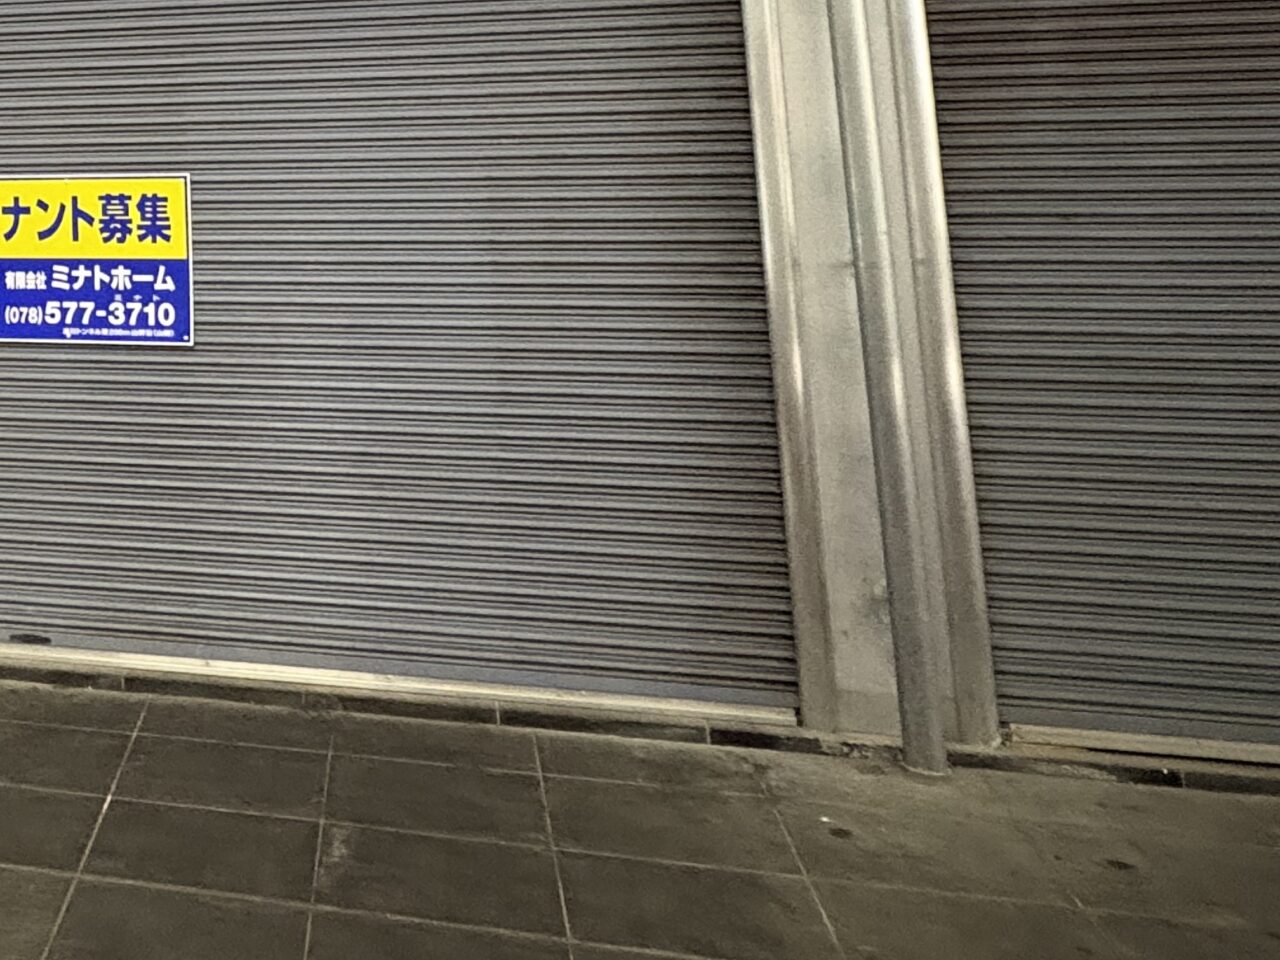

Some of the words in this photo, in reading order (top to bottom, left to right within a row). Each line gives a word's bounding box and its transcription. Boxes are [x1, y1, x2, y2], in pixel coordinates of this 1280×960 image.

[4, 270, 47, 290] 有限会社
[51, 264, 176, 292] ミナトホーム
[4, 300, 177, 327] (078)577-3710
